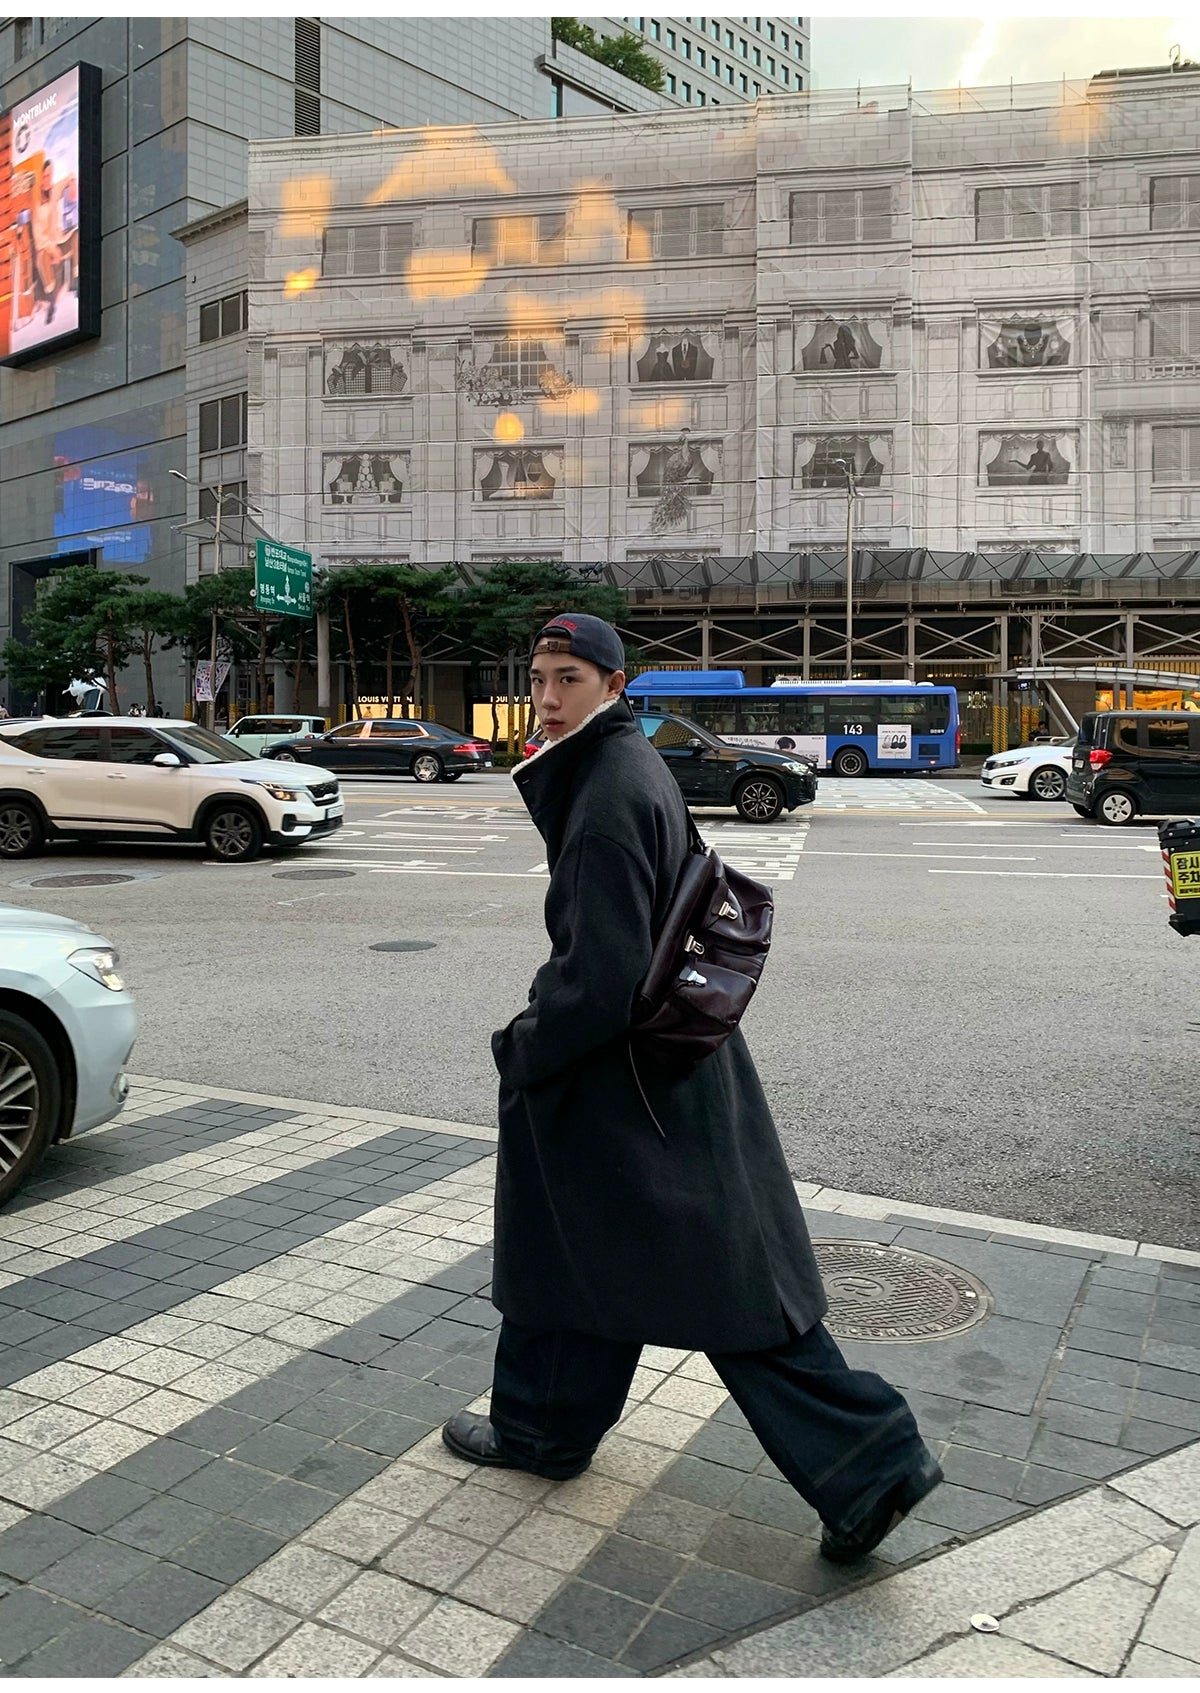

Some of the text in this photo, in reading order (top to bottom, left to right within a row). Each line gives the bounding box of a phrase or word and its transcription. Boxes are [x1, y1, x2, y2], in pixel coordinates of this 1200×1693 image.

[13, 93, 57, 128] MONTBLANC
[358, 695, 380, 703] LOUIS
[843, 724, 863, 735] 143
[1176, 856, 1200, 870] 잠시
